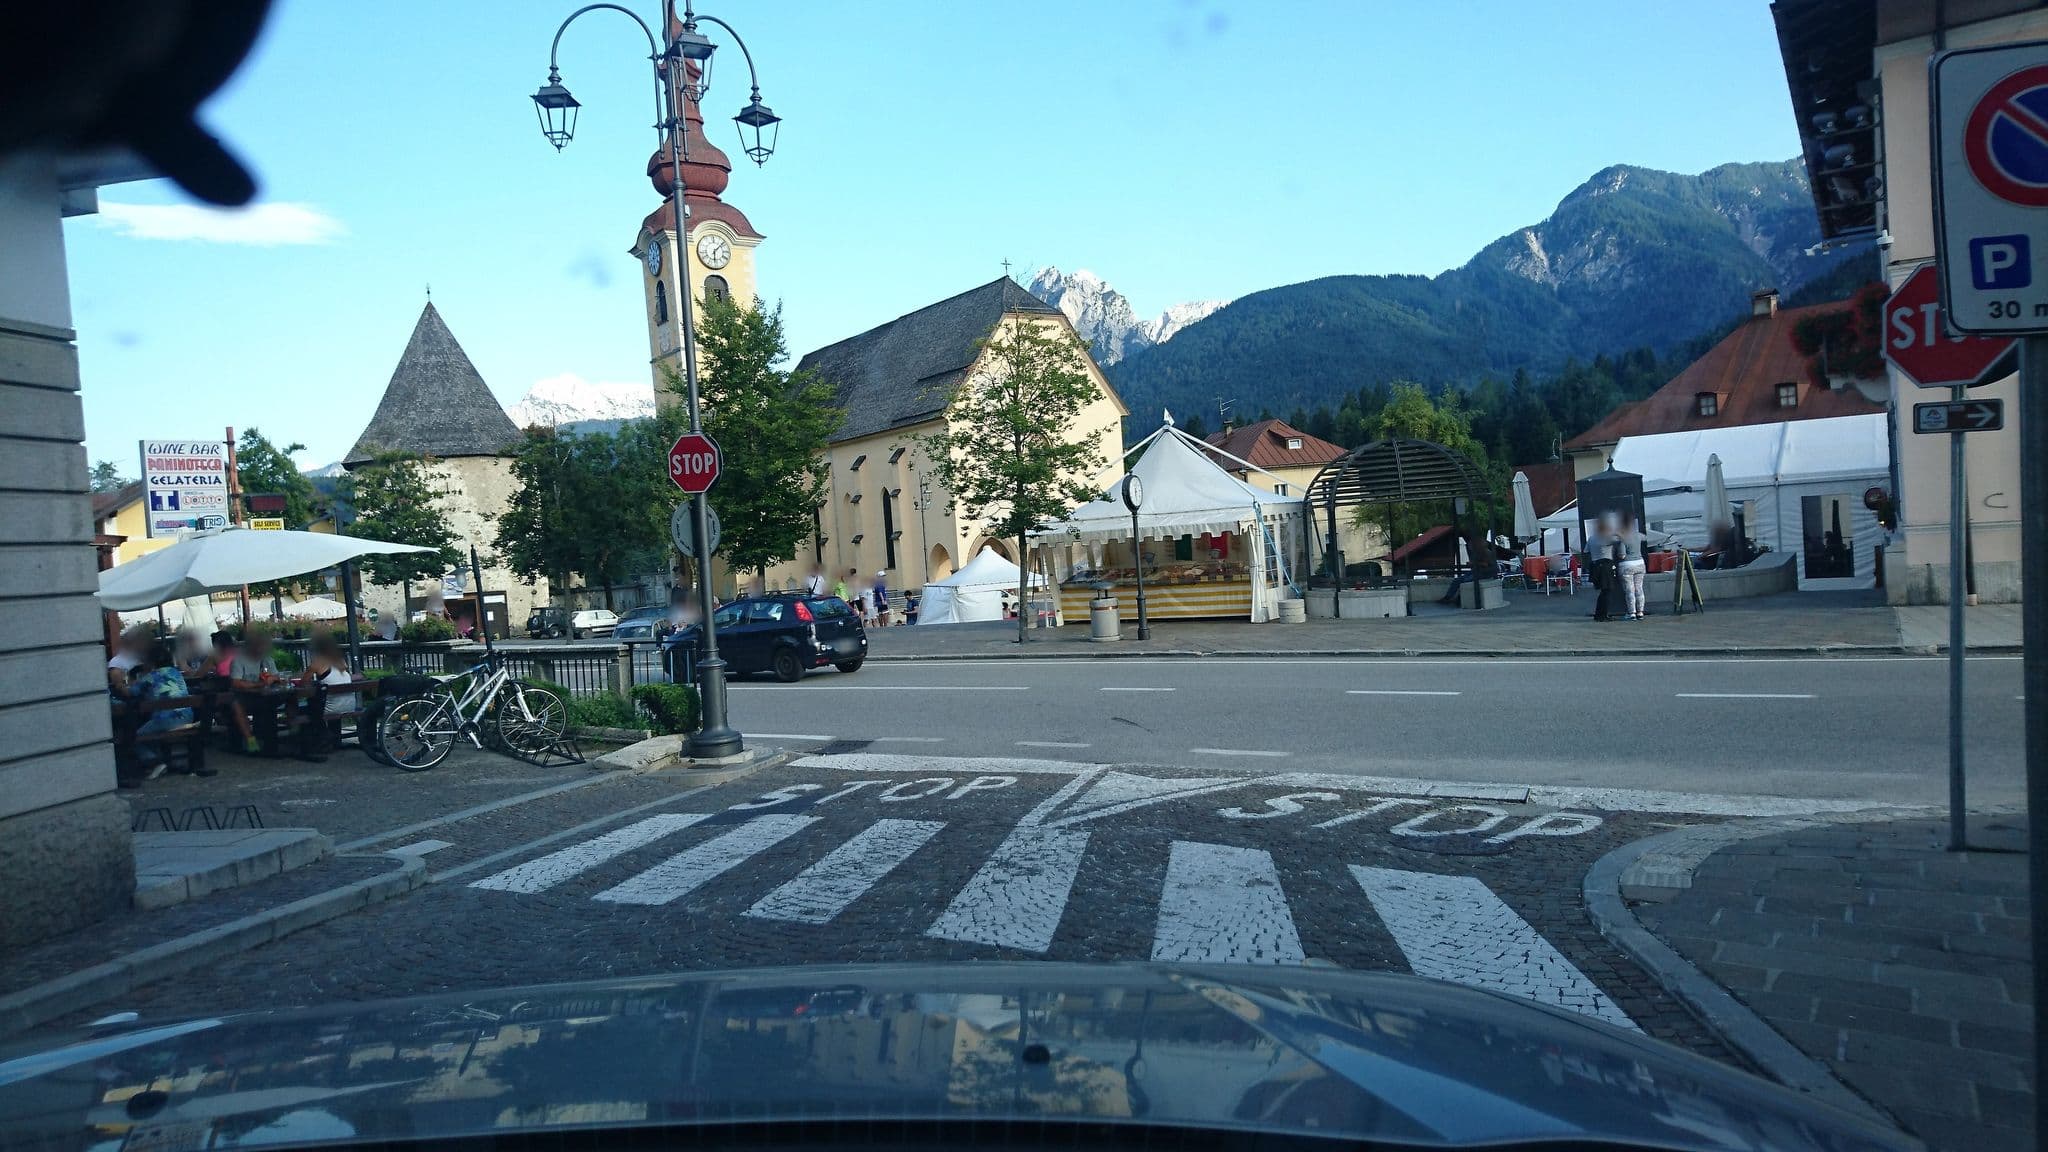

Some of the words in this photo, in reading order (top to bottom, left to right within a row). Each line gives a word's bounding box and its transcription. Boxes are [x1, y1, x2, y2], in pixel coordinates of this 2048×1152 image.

[1982, 243, 2017, 283] P
[1988, 301, 2021, 319] 30
[148, 443, 186, 455] WINE
[190, 443, 220, 455] BAR
[147, 457, 222, 471] PANINOTECA
[671, 452, 714, 475] STOP
[150, 475, 222, 485] GELATERIA
[728, 776, 1018, 812] STOP
[1217, 791, 1604, 844] STOP
